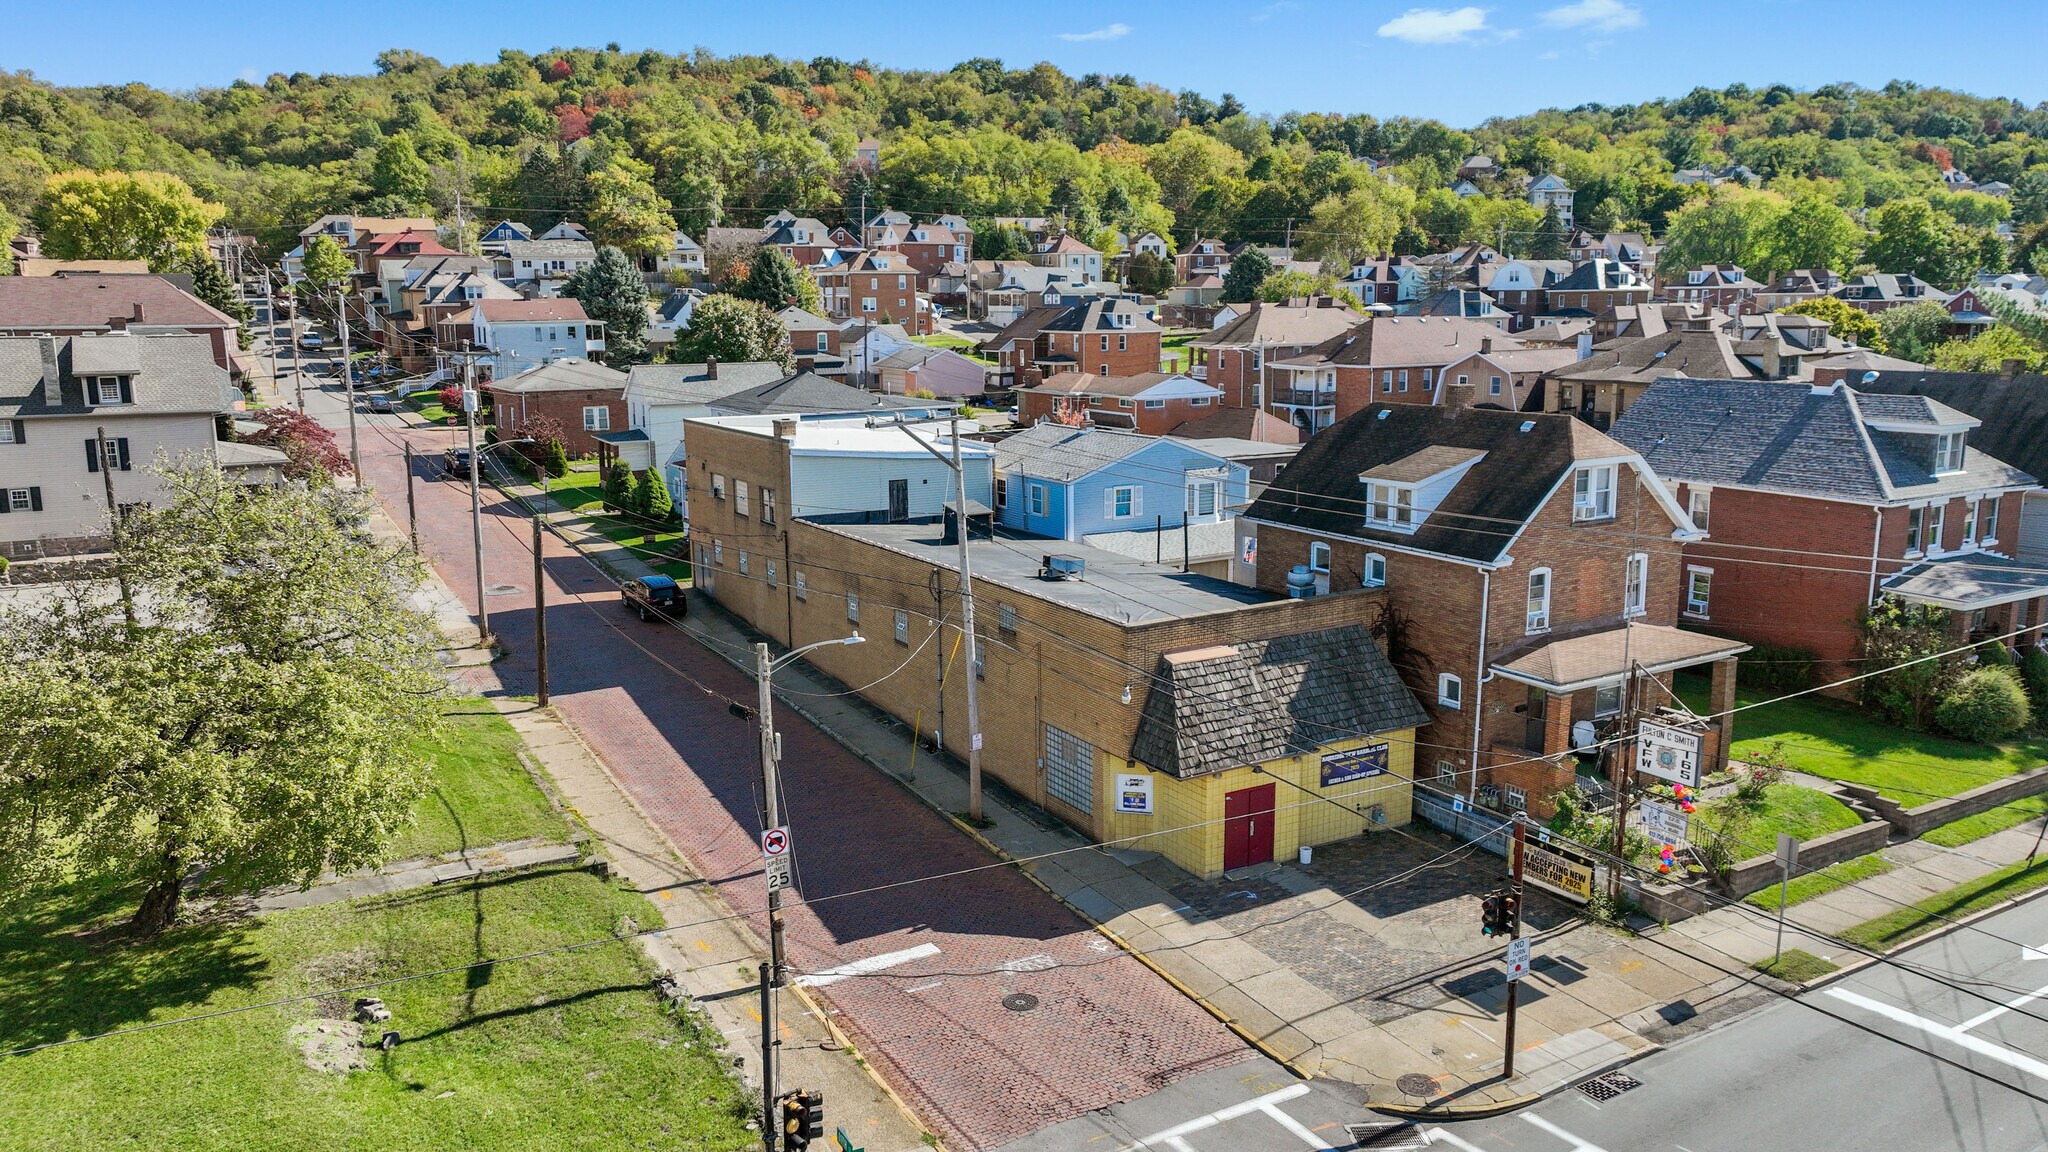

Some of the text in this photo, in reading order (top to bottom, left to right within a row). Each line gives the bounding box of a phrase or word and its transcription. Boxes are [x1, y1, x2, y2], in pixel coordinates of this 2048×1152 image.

[1667, 733, 1671, 741] C
[1674, 735, 1694, 747] SMITH
[767, 857, 788, 868] SPEED
[1530, 854, 1568, 876] ACCEPTING
[1570, 870, 1586, 883] NEW
[770, 865, 786, 874] LIMIT
[1523, 860, 1581, 890] EMBERS FOR 2025
[769, 872, 789, 888] 25
[1514, 941, 1524, 949] NO
[1512, 948, 1526, 957] TURN
